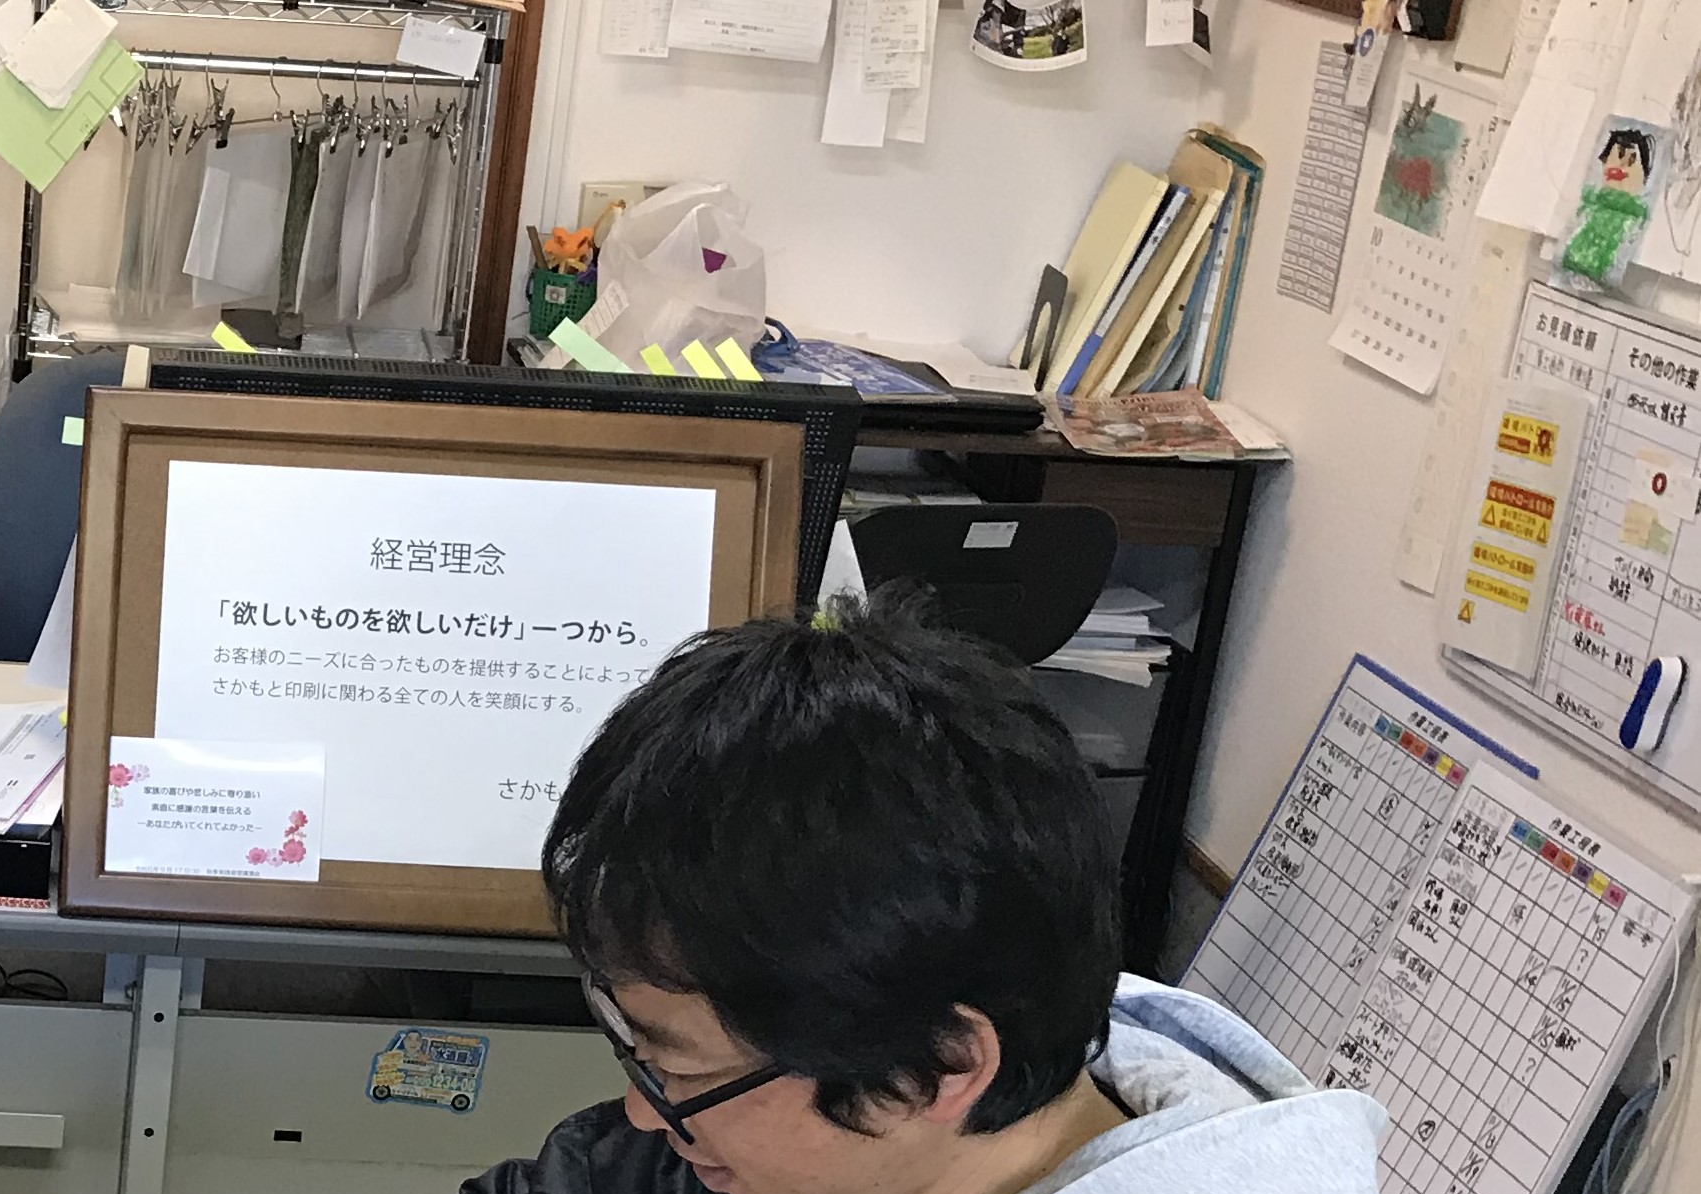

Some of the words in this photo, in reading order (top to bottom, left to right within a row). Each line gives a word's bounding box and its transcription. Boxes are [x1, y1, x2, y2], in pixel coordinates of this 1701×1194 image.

[370, 537, 506, 576] 経営理念
[212, 676, 584, 715] さかもと印刷に関わる全ての人を笑顔にする。
